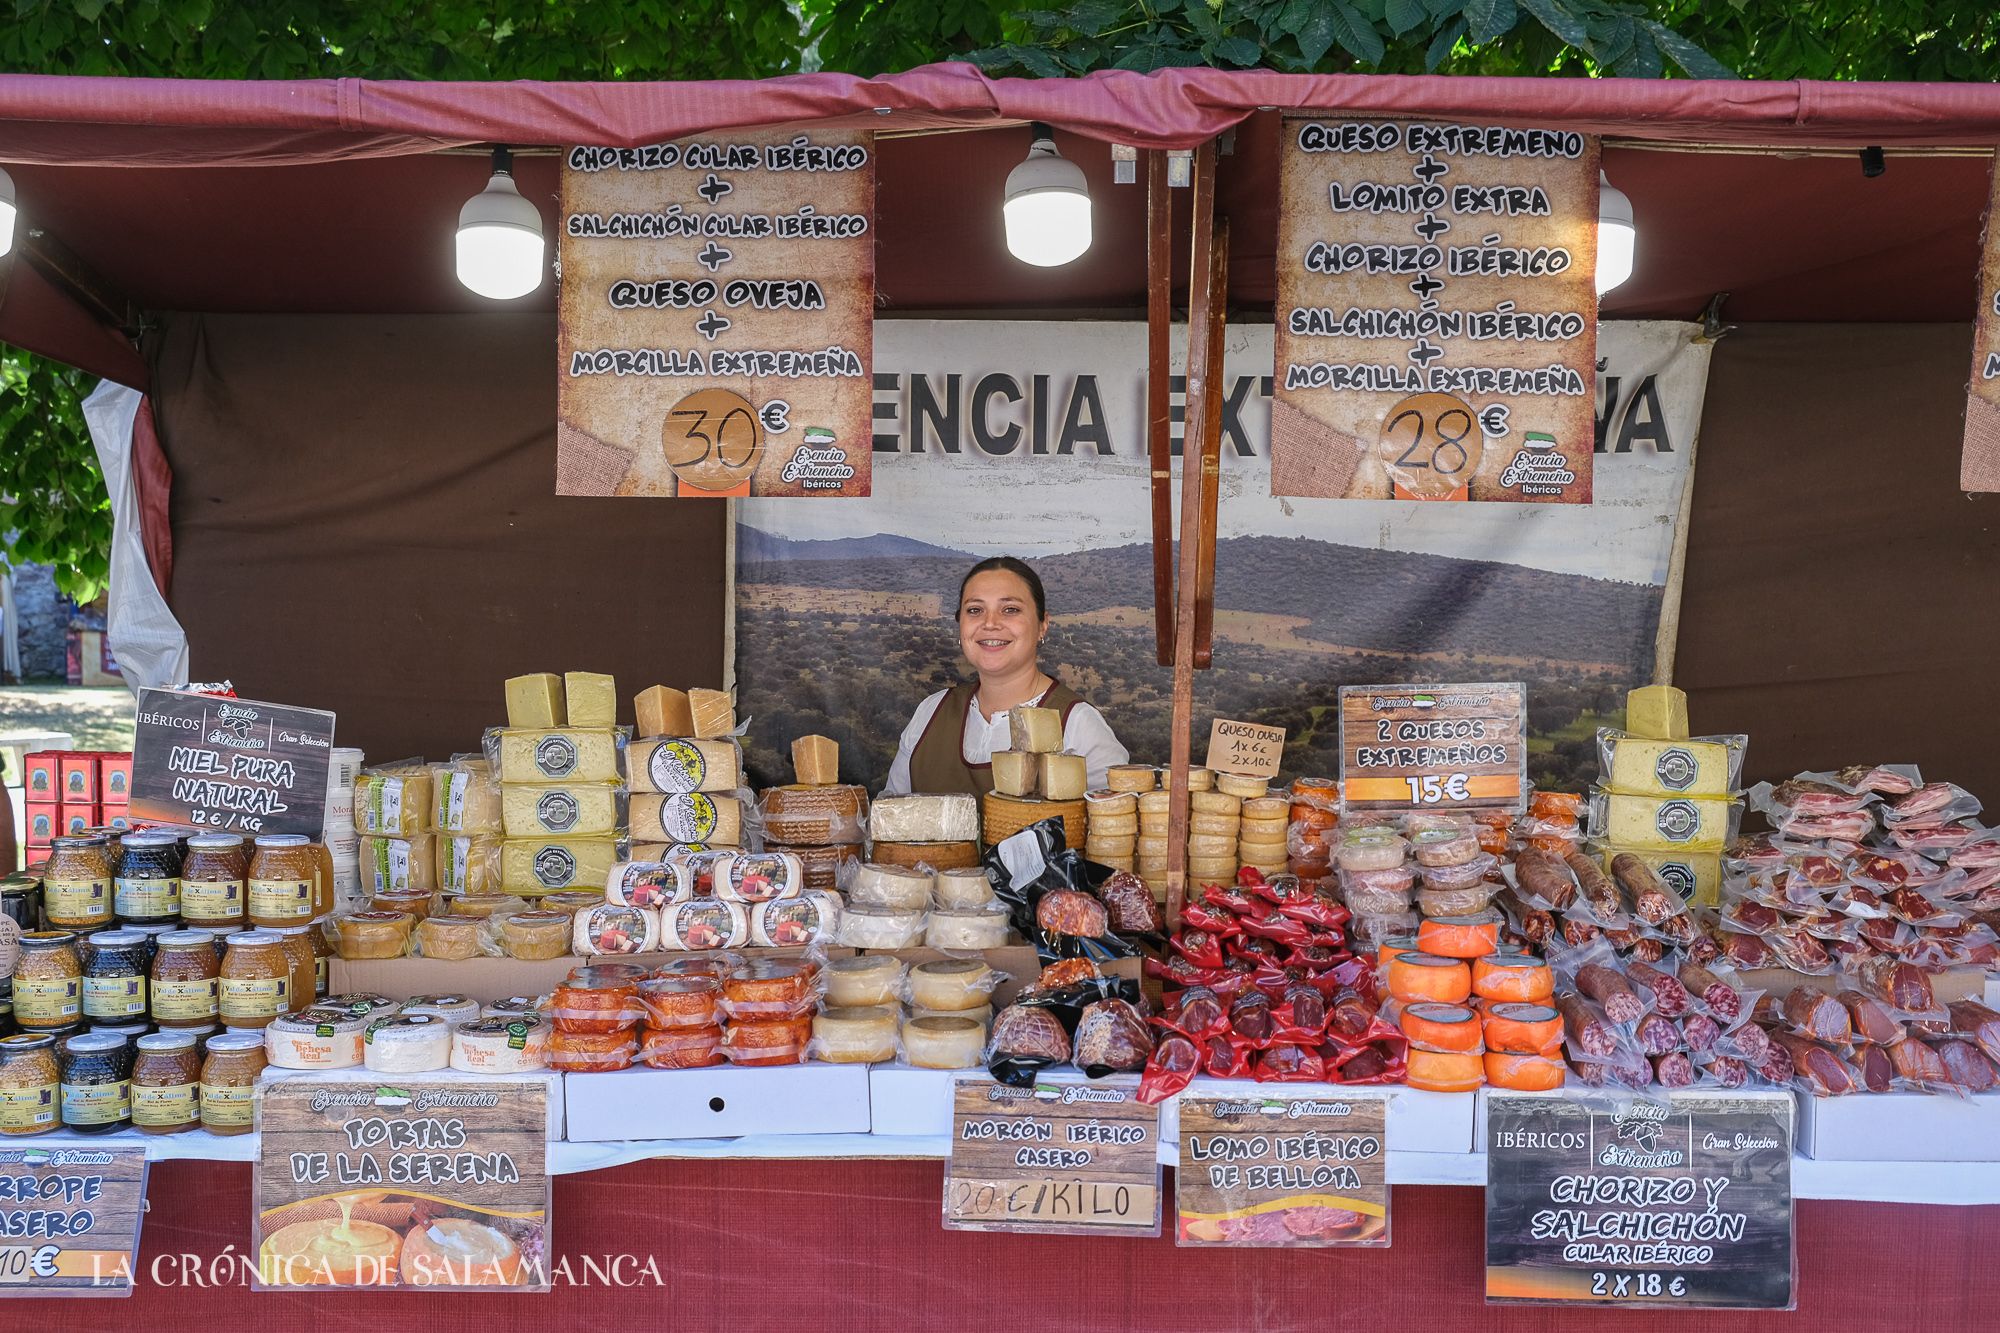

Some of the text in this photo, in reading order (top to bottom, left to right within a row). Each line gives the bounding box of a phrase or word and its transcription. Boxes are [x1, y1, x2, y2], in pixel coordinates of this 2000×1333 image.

[1300, 125, 1399, 151] QUESO
[570, 138, 867, 169] CHORIZO CULAR IBÉRICO
[1329, 183, 1551, 215] LOMITO EXTRA
[569, 206, 868, 237] SALCHICHÓN CULAR IBÉRICO
[1305, 236, 1570, 276] CHORIZO IBÉRICO
[609, 281, 825, 308] QUESO OVEJA
[1290, 302, 1584, 340] SALCHICHÓN IBÉRICO
[571, 347, 863, 376] MORCILLA EXTREMEÑA
[1286, 363, 1585, 395] MORCILLA EXTREMEÑA
[672, 401, 790, 467] 30 €
[1387, 404, 1509, 474] 28 €
[794, 447, 845, 464] Esencia
[1513, 451, 1566, 468] Esencia
[782, 462, 854, 481] Extremeña
[1501, 468, 1574, 486] Extremeña
[803, 480, 842, 489] Ibéricos
[1522, 484, 1561, 495] Ibéricos
[139, 712, 199, 730] IBÉRICOS
[218, 704, 258, 720] Esencia
[208, 730, 264, 749] Extremeña
[279, 731, 297, 743] Gran
[1218, 722, 1254, 738] QUESO
[1377, 719, 1485, 741] 2 QUESOS
[1356, 743, 1506, 767] EXTREMEÑOS
[169, 747, 295, 788] MIEL PURA
[173, 778, 288, 815] NATURAL
[191, 810, 205, 824] 12
[239, 816, 263, 832] KG
[312, 1090, 498, 1111] Esencia Extremeña
[1063, 1087, 1125, 1104] Extremeña
[1288, 1101, 1351, 1118] Extremeña
[344, 1118, 466, 1149] TORTAS
[963, 1117, 1147, 1143] MORCÓN IBÉRICO
[1496, 1129, 1585, 1149] IBÉRICOS
[1702, 1132, 1779, 1150] Gran Selección
[1015, 1147, 1091, 1168] CASERO
[1191, 1131, 1379, 1161] LOMO IBÉRICO
[1600, 1144, 1682, 1168] Extremeña
[51, 1150, 113, 1167] Extremeña
[290, 1152, 519, 1184] DE LA SERENA
[1210, 1165, 1361, 1189] DE BELLOTA
[954, 1183, 996, 1215] 20
[1551, 1176, 1729, 1207] CHORIZO Y
[1531, 1204, 1746, 1241] SALCHICHÓN
[1563, 1241, 1713, 1266] CULAR IBÉRICO
[1591, 1272, 1607, 1296] 2
[1637, 1273, 1662, 1296] 18
